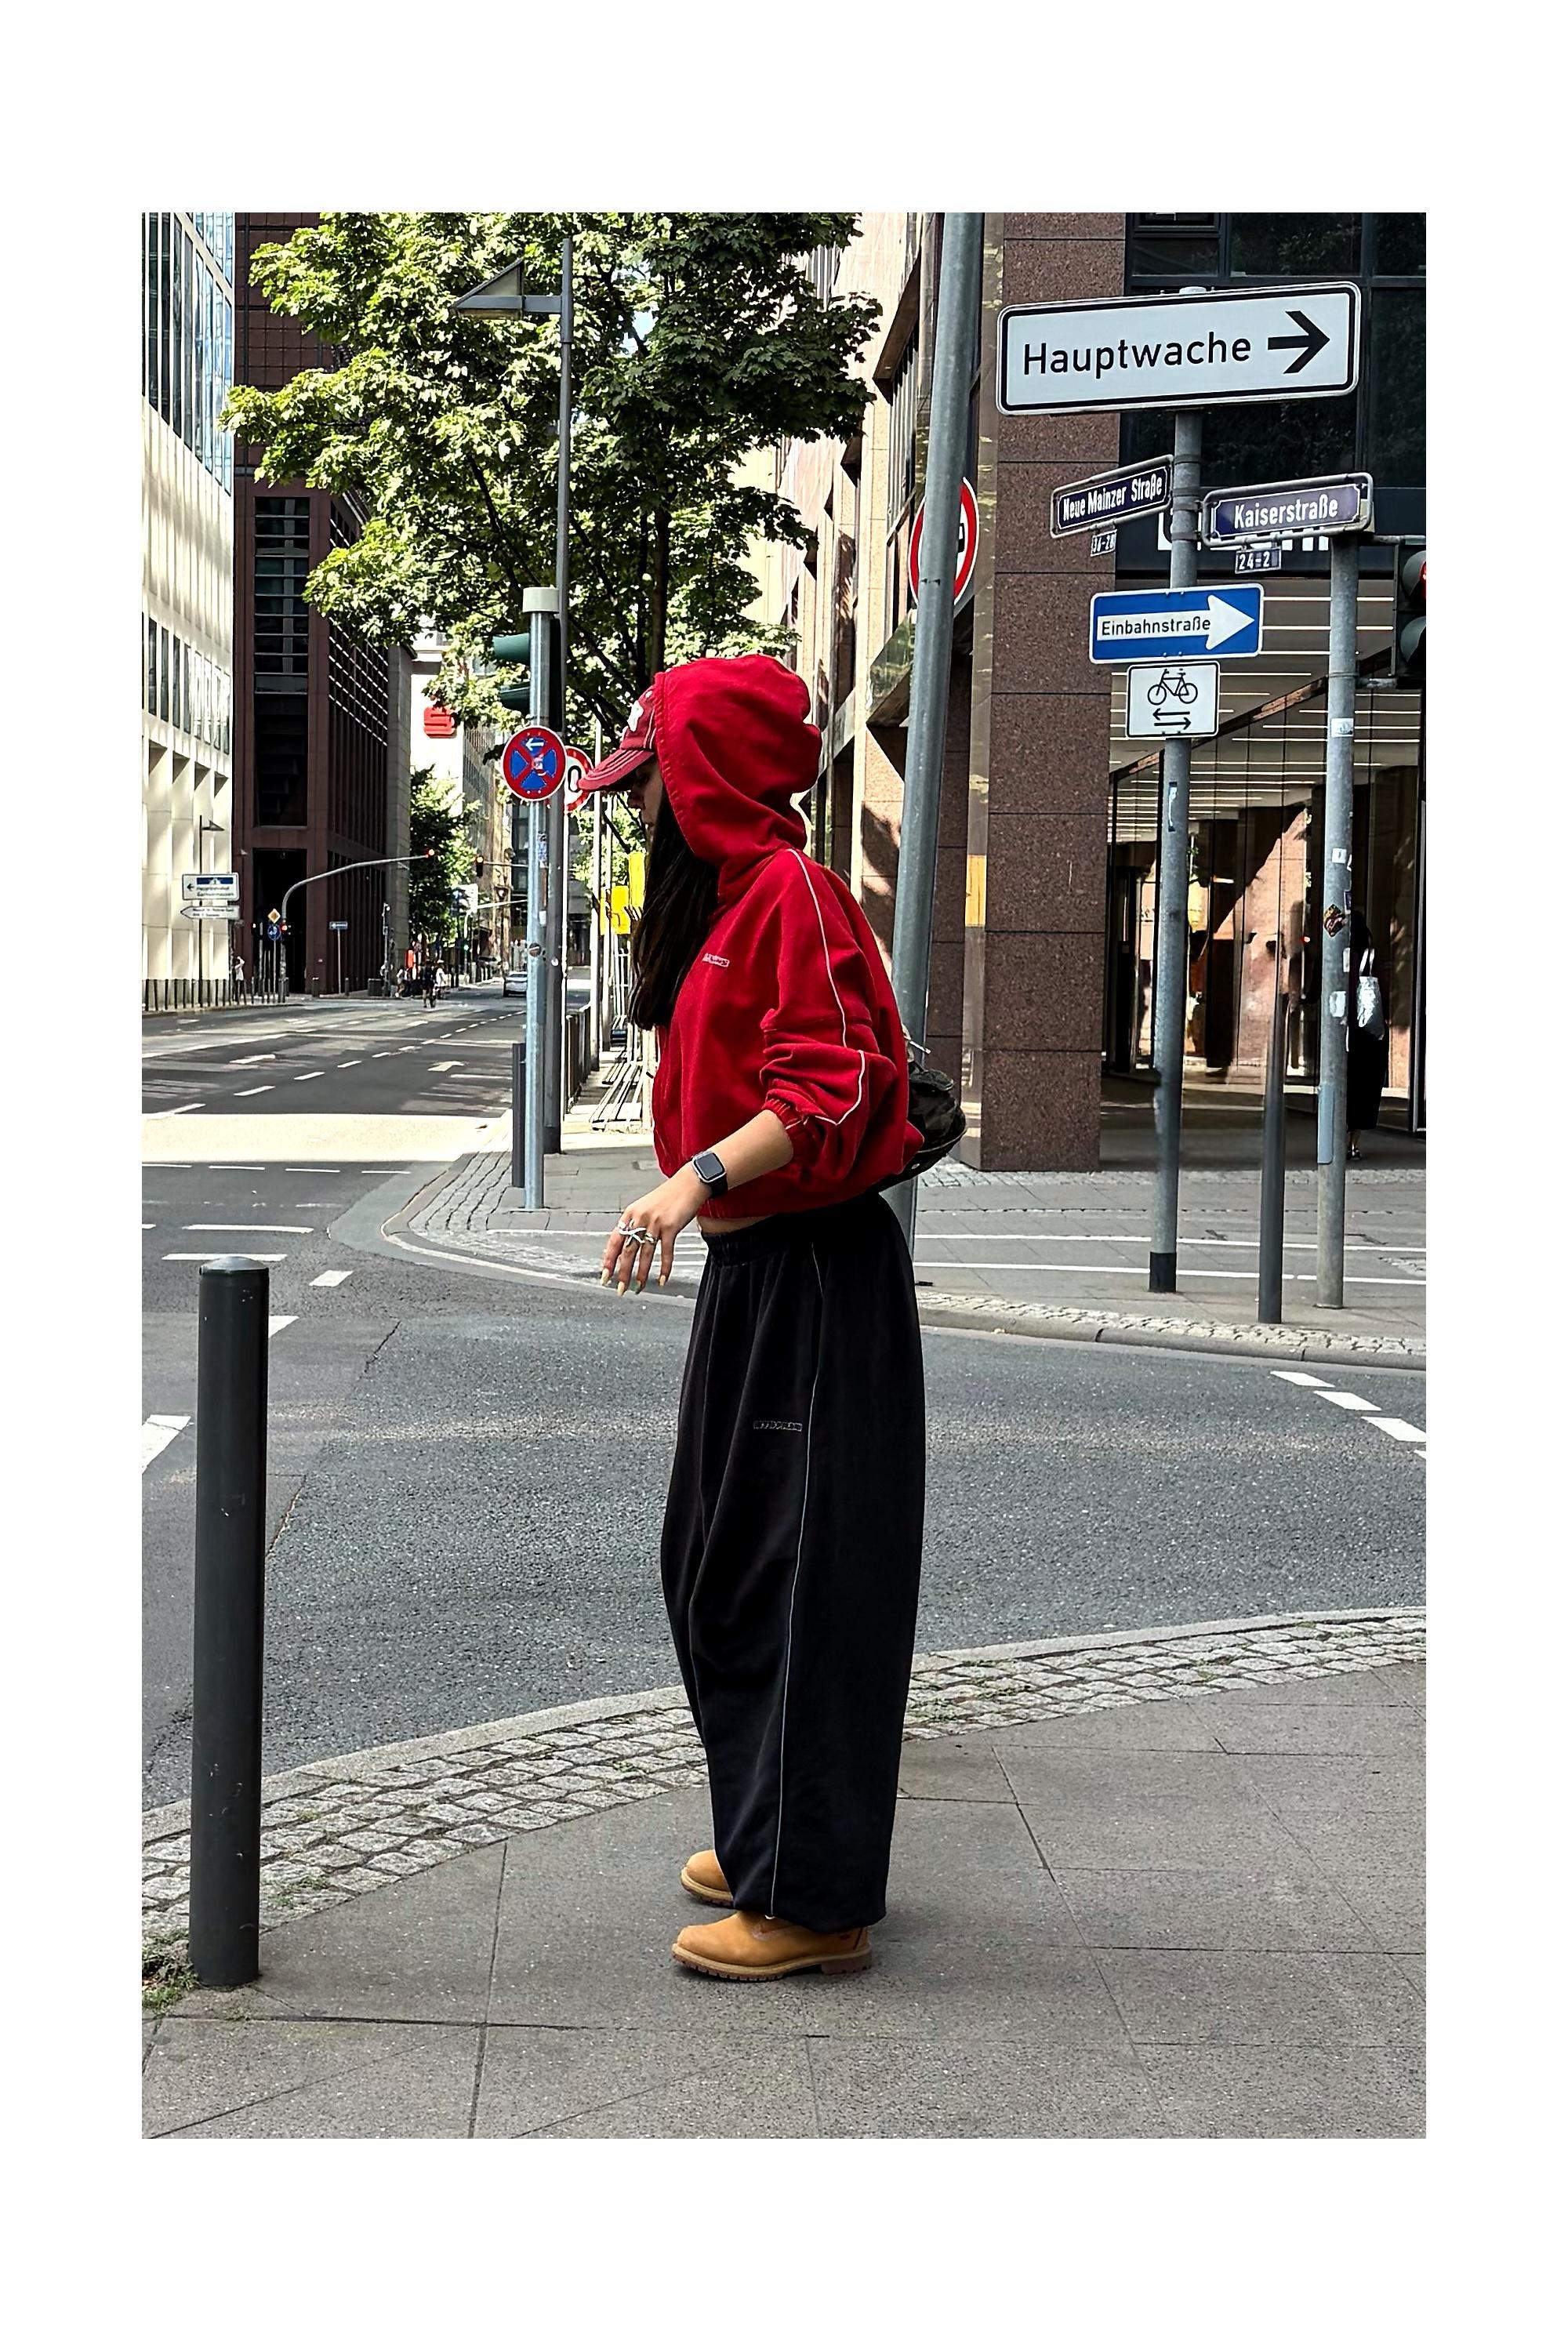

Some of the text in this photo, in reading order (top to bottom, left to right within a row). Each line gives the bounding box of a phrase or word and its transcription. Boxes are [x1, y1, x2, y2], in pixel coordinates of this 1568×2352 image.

[1023, 331, 1251, 379] Hauptwache
[1063, 474, 1163, 521] Neue Mainzer Straße
[1234, 494, 1338, 529] Kaiserstraße
[1102, 616, 1211, 636] Einbahnstraße
[568, 765, 583, 793] 0
